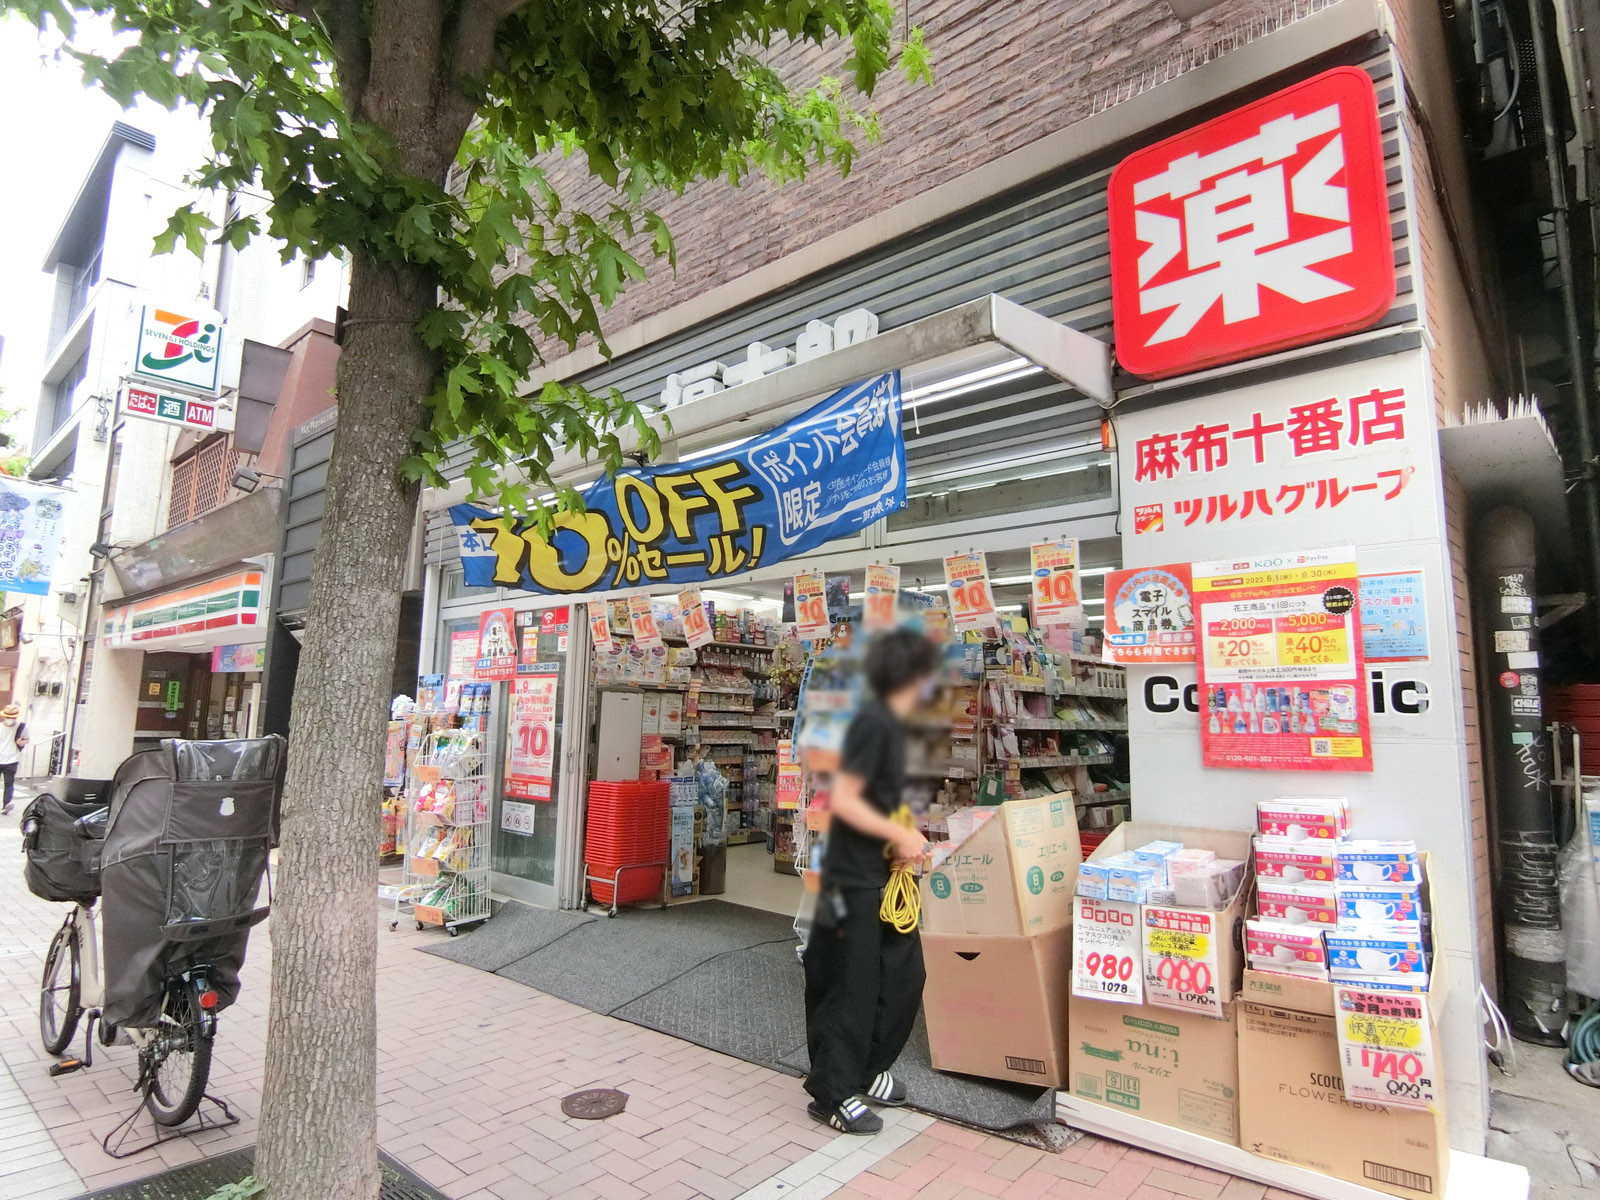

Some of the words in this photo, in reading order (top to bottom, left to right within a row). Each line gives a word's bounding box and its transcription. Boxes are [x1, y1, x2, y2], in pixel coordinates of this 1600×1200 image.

[1133, 102, 1355, 347] 薬
[178, 339, 216, 354] HOLDINGS
[128, 391, 156, 412] たばこ
[162, 399, 182, 417] 酒
[188, 405, 212, 424] ATM
[1134, 387, 1406, 484] 麻布十番店
[614, 461, 756, 543] OFF
[1174, 465, 1416, 528] ツルハグループ
[782, 480, 821, 534] 限定
[1136, 505, 1161, 515] ツルハ
[953, 581, 986, 609] 10
[1037, 572, 1074, 603] 10
[1139, 589, 1164, 603] 電子
[799, 597, 825, 623] 10
[1132, 606, 1172, 618] スマイル
[1132, 618, 1173, 632] 商品券
[1220, 618, 1257, 631] 2,000
[1288, 613, 1327, 627] 5,000
[1227, 639, 1250, 657] 20
[1296, 635, 1322, 653] 40
[518, 724, 548, 757] 10
[1038, 842, 1068, 858] エリエール
[941, 853, 994, 868] エリエール
[936, 879, 945, 892] 8
[1032, 873, 1041, 887] 8
[1081, 906, 1134, 926] おすすめ
[1086, 951, 1133, 982] 980
[1157, 957, 1211, 995] 980
[1101, 981, 1128, 994] 1078
[1356, 993, 1412, 1006] ふくちゃんの
[1354, 1002, 1422, 1019] 今月のお得!
[1349, 1022, 1408, 1040] 快適マスク
[1132, 1062, 1172, 1078] エリエール
[1420, 1078, 1432, 1088] 円
